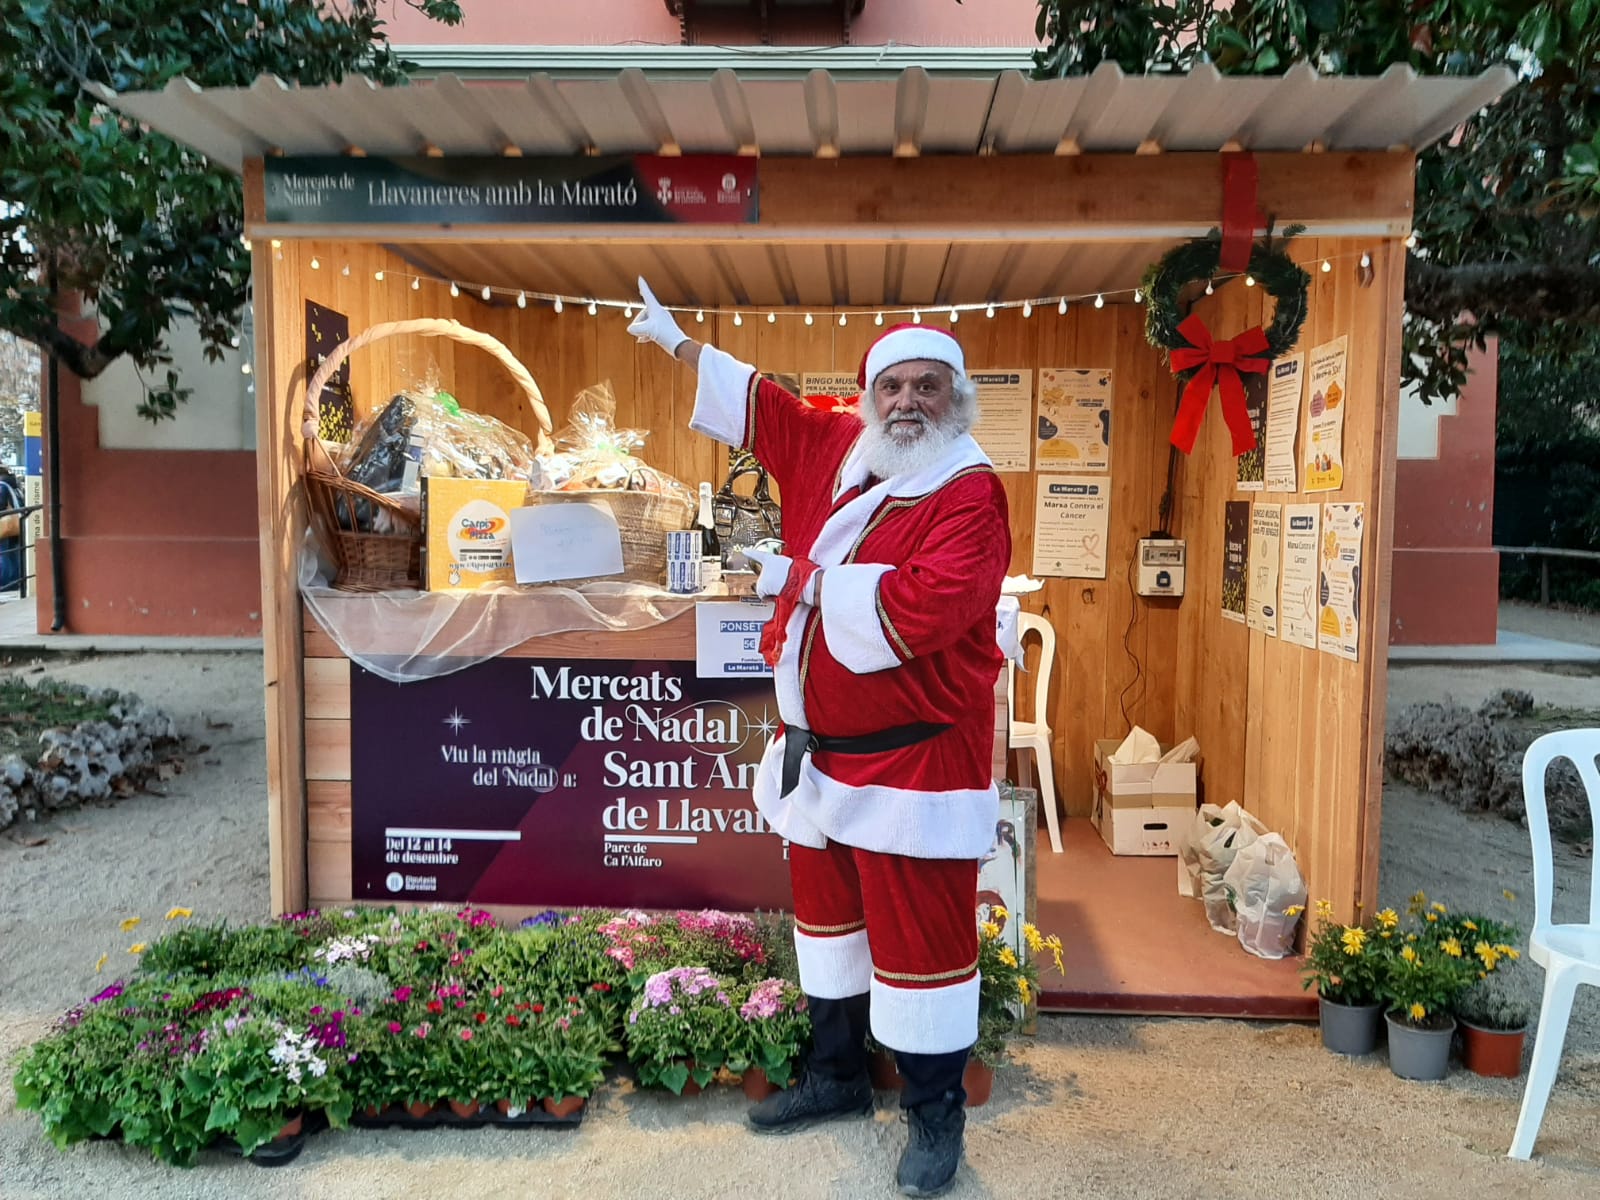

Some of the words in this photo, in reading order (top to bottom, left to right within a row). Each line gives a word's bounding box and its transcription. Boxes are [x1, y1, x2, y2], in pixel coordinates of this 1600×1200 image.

[283, 173, 336, 190] Mercats
[339, 172, 355, 190] de
[368, 179, 480, 206] Llavaneres
[485, 179, 532, 206] amb
[538, 179, 555, 206] la
[561, 178, 637, 206] Marató
[806, 377, 832, 385] BINGO
[835, 377, 859, 385] MUSI
[1070, 502, 1095, 510] Contra
[721, 622, 761, 632] PONSET
[744, 639, 755, 649] 5€
[530, 666, 682, 701] Mercats
[580, 706, 623, 741] de
[627, 704, 743, 747] Nadal
[441, 744, 468, 763] Viu
[473, 744, 487, 763] la
[473, 767, 498, 786] del
[502, 766, 555, 789] Nadal
[563, 773, 577, 787] a:
[603, 751, 698, 788] Sant
[602, 797, 649, 831] de
[386, 838, 404, 850] Del
[408, 838, 421, 851] 12
[424, 838, 434, 851] al
[438, 838, 452, 851] 14
[604, 843, 634, 853] Parc
[636, 843, 647, 853] de
[386, 850, 400, 863] de
[402, 851, 459, 864] desembre
[604, 855, 618, 866] Ca
